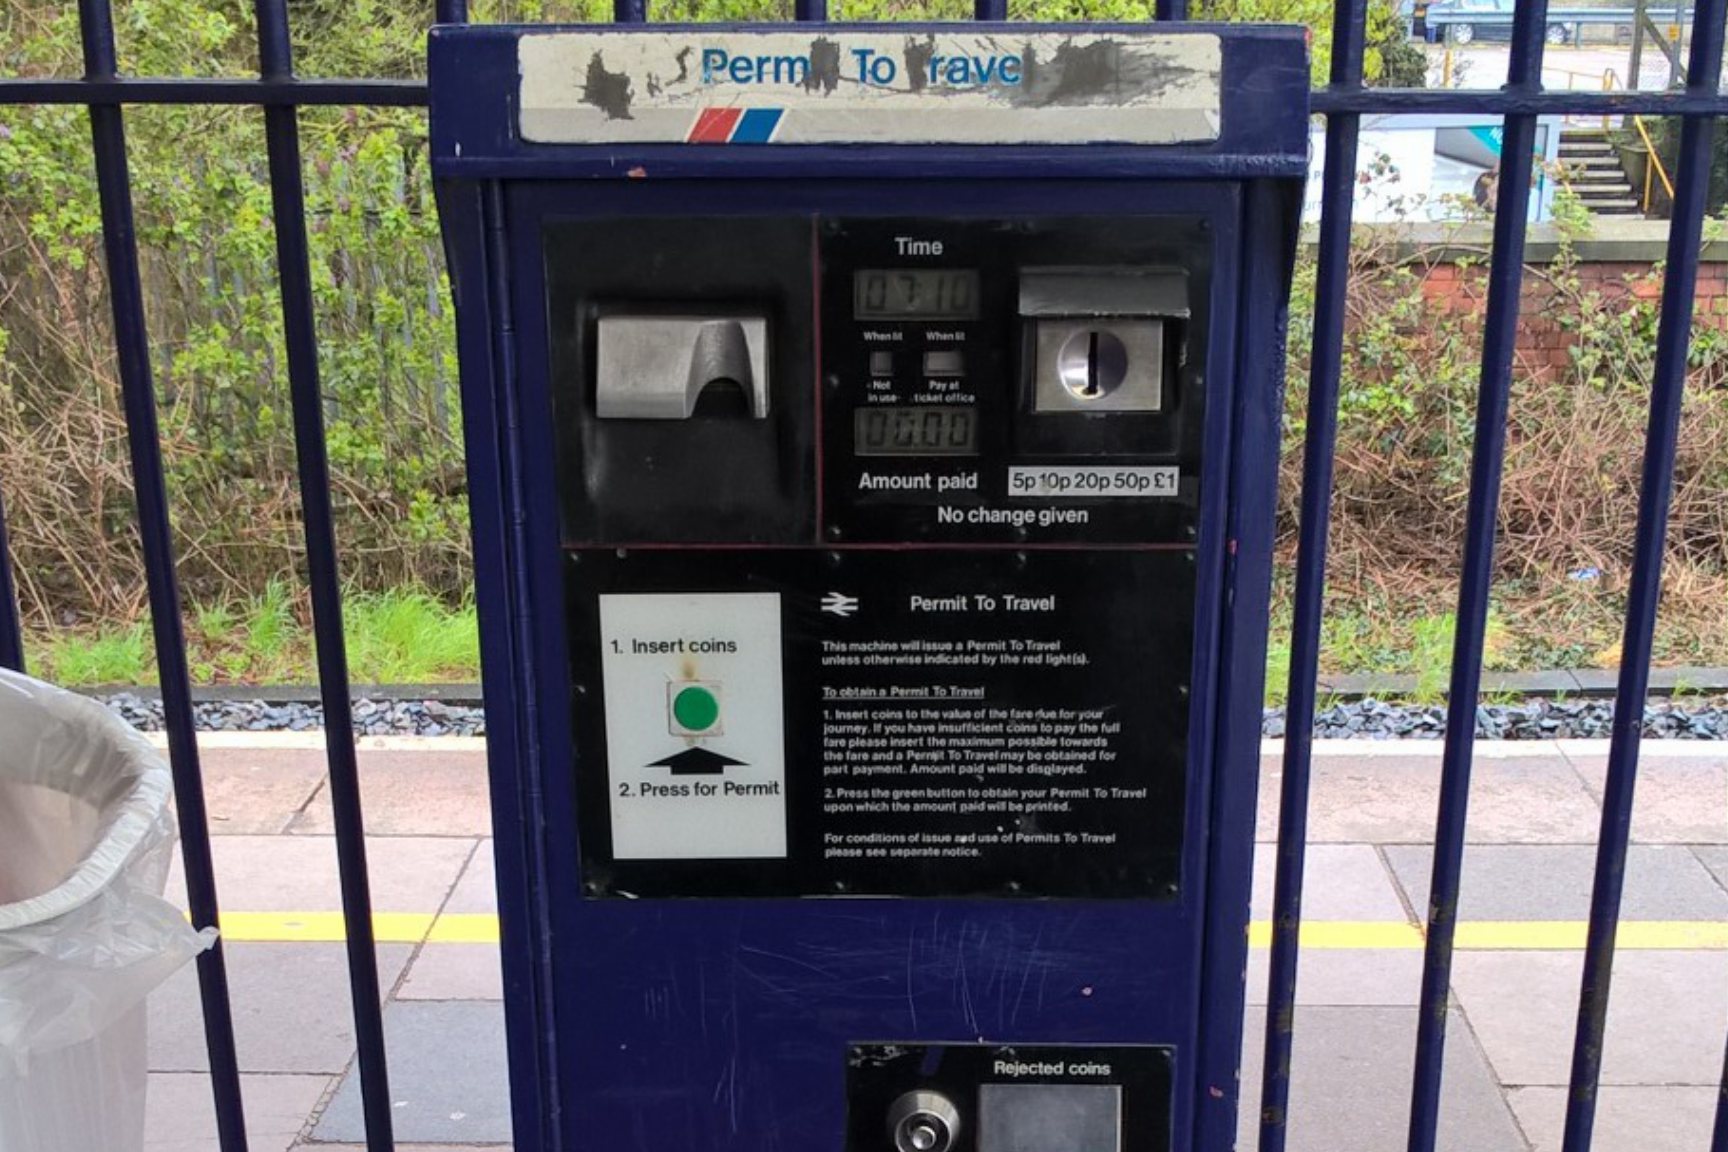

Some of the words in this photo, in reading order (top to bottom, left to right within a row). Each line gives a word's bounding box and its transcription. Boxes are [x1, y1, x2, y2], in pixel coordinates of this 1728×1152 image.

[702, 48, 814, 84] Perm
[851, 48, 896, 84] To
[895, 236, 944, 256] Time
[863, 331, 891, 341] When
[892, 331, 903, 341] lit
[926, 331, 954, 341] When
[955, 331, 965, 341] lit
[873, 380, 891, 391] Not
[929, 380, 948, 392] Pay
[949, 380, 960, 391] at
[867, 393, 878, 403] in
[879, 394, 897, 403] use
[913, 393, 943, 403] ticket
[944, 393, 975, 403] office
[858, 473, 931, 489] Amount
[937, 472, 978, 492] paid
[1012, 473, 1036, 490] 5p
[1039, 472, 1071, 490] 10p
[1074, 472, 1110, 490] 20p
[1113, 472, 1150, 490] 50p
[1154, 472, 1175, 489] £1
[938, 506, 963, 522] No
[967, 506, 1036, 527] change
[1038, 506, 1089, 527] given
[911, 595, 968, 611] Permit
[975, 595, 996, 611] To
[1002, 595, 1055, 611] Travel
[610, 640, 624, 654] 1.
[632, 638, 684, 654] Insert
[689, 638, 737, 653] coins
[822, 640, 847, 651] This
[849, 640, 898, 651] machine
[900, 640, 920, 651] will
[922, 640, 952, 651] issue
[967, 640, 1006, 651] Permit
[1010, 639, 1023, 650] To
[1026, 639, 1060, 650] Travel
[822, 654, 860, 665] unless
[863, 654, 922, 665] otherwise
[924, 653, 978, 664] indicated
[982, 654, 997, 665] by
[1000, 653, 1019, 664] the
[1023, 653, 1042, 664] red
[823, 686, 836, 697] To
[840, 686, 876, 697] obtain
[891, 686, 929, 697] Permit
[932, 686, 946, 697] To
[949, 686, 984, 697] Travel
[823, 709, 832, 720] 1.
[836, 709, 869, 720] Insert
[872, 709, 903, 720] coins
[906, 709, 917, 720] to
[921, 709, 939, 720] the
[942, 708, 971, 719] value
[974, 708, 985, 719] of
[989, 708, 1007, 719] the
[1010, 708, 1033, 719] fare
[1035, 708, 1056, 719] due
[1059, 708, 1074, 719] for
[1079, 710, 1103, 721] your
[823, 724, 870, 735] journey.
[873, 722, 881, 733] If
[884, 724, 906, 735] you
[908, 722, 935, 733] have
[938, 722, 1003, 733] insufficient
[1007, 722, 1037, 733] coins
[1040, 722, 1052, 733] to
[1054, 724, 1076, 735] pay
[1079, 722, 1098, 733] the
[1101, 722, 1120, 733] full
[824, 736, 846, 747] fare
[849, 737, 887, 748] please
[890, 736, 923, 747] insert
[927, 736, 946, 747] the
[949, 736, 1004, 747] maximum
[1008, 736, 1056, 748] possible
[1060, 736, 1108, 747] towards
[824, 750, 843, 761] the
[846, 750, 869, 761] fare
[872, 750, 893, 761] and
[907, 749, 944, 760] Permit
[948, 749, 961, 760] To
[964, 749, 998, 760] Travel
[1001, 751, 1024, 762] may
[1027, 749, 1041, 760] be
[1044, 750, 1096, 761] obtained
[1099, 749, 1116, 760] for
[824, 764, 847, 775] part
[852, 764, 907, 775] payment.
[910, 763, 955, 774] Amount
[958, 764, 984, 775] paid
[987, 763, 1006, 774] will
[1009, 763, 1023, 774] be
[1027, 764, 1086, 776] displayed.
[619, 783, 636, 797] 2.
[640, 782, 690, 796] Press
[694, 781, 718, 796] for
[723, 780, 780, 795] Permit
[825, 787, 835, 798] 2.
[837, 787, 869, 798] Press
[871, 788, 889, 799] the
[892, 789, 925, 800] green
[927, 787, 965, 798] button
[968, 787, 979, 798] to
[982, 787, 1018, 798] obtain
[1021, 789, 1046, 800] your
[1050, 787, 1089, 798] Permit
[1093, 787, 1108, 798] To
[1111, 787, 1147, 798] Travel
[824, 803, 853, 814] upon
[856, 801, 889, 812] which
[892, 801, 910, 812] the
[913, 801, 956, 812] amount
[960, 801, 985, 812] paid
[987, 800, 1006, 811] will
[1008, 801, 1023, 812] be
[1026, 801, 1071, 813] printed.
[825, 832, 843, 843] For
[846, 832, 905, 843] conditions
[908, 832, 919, 843] of
[922, 833, 951, 844] issue
[954, 832, 975, 843] and
[978, 834, 998, 843] use
[1001, 832, 1013, 843] of
[1016, 832, 1060, 843] Permits
[1064, 832, 1077, 843] To
[1081, 832, 1115, 843] Travel
[825, 847, 862, 858] please
[866, 848, 886, 857] see
[890, 846, 940, 857] separate
[942, 846, 981, 857] notice.
[994, 1061, 1064, 1077] Rejected
[1068, 1062, 1111, 1076] coins
